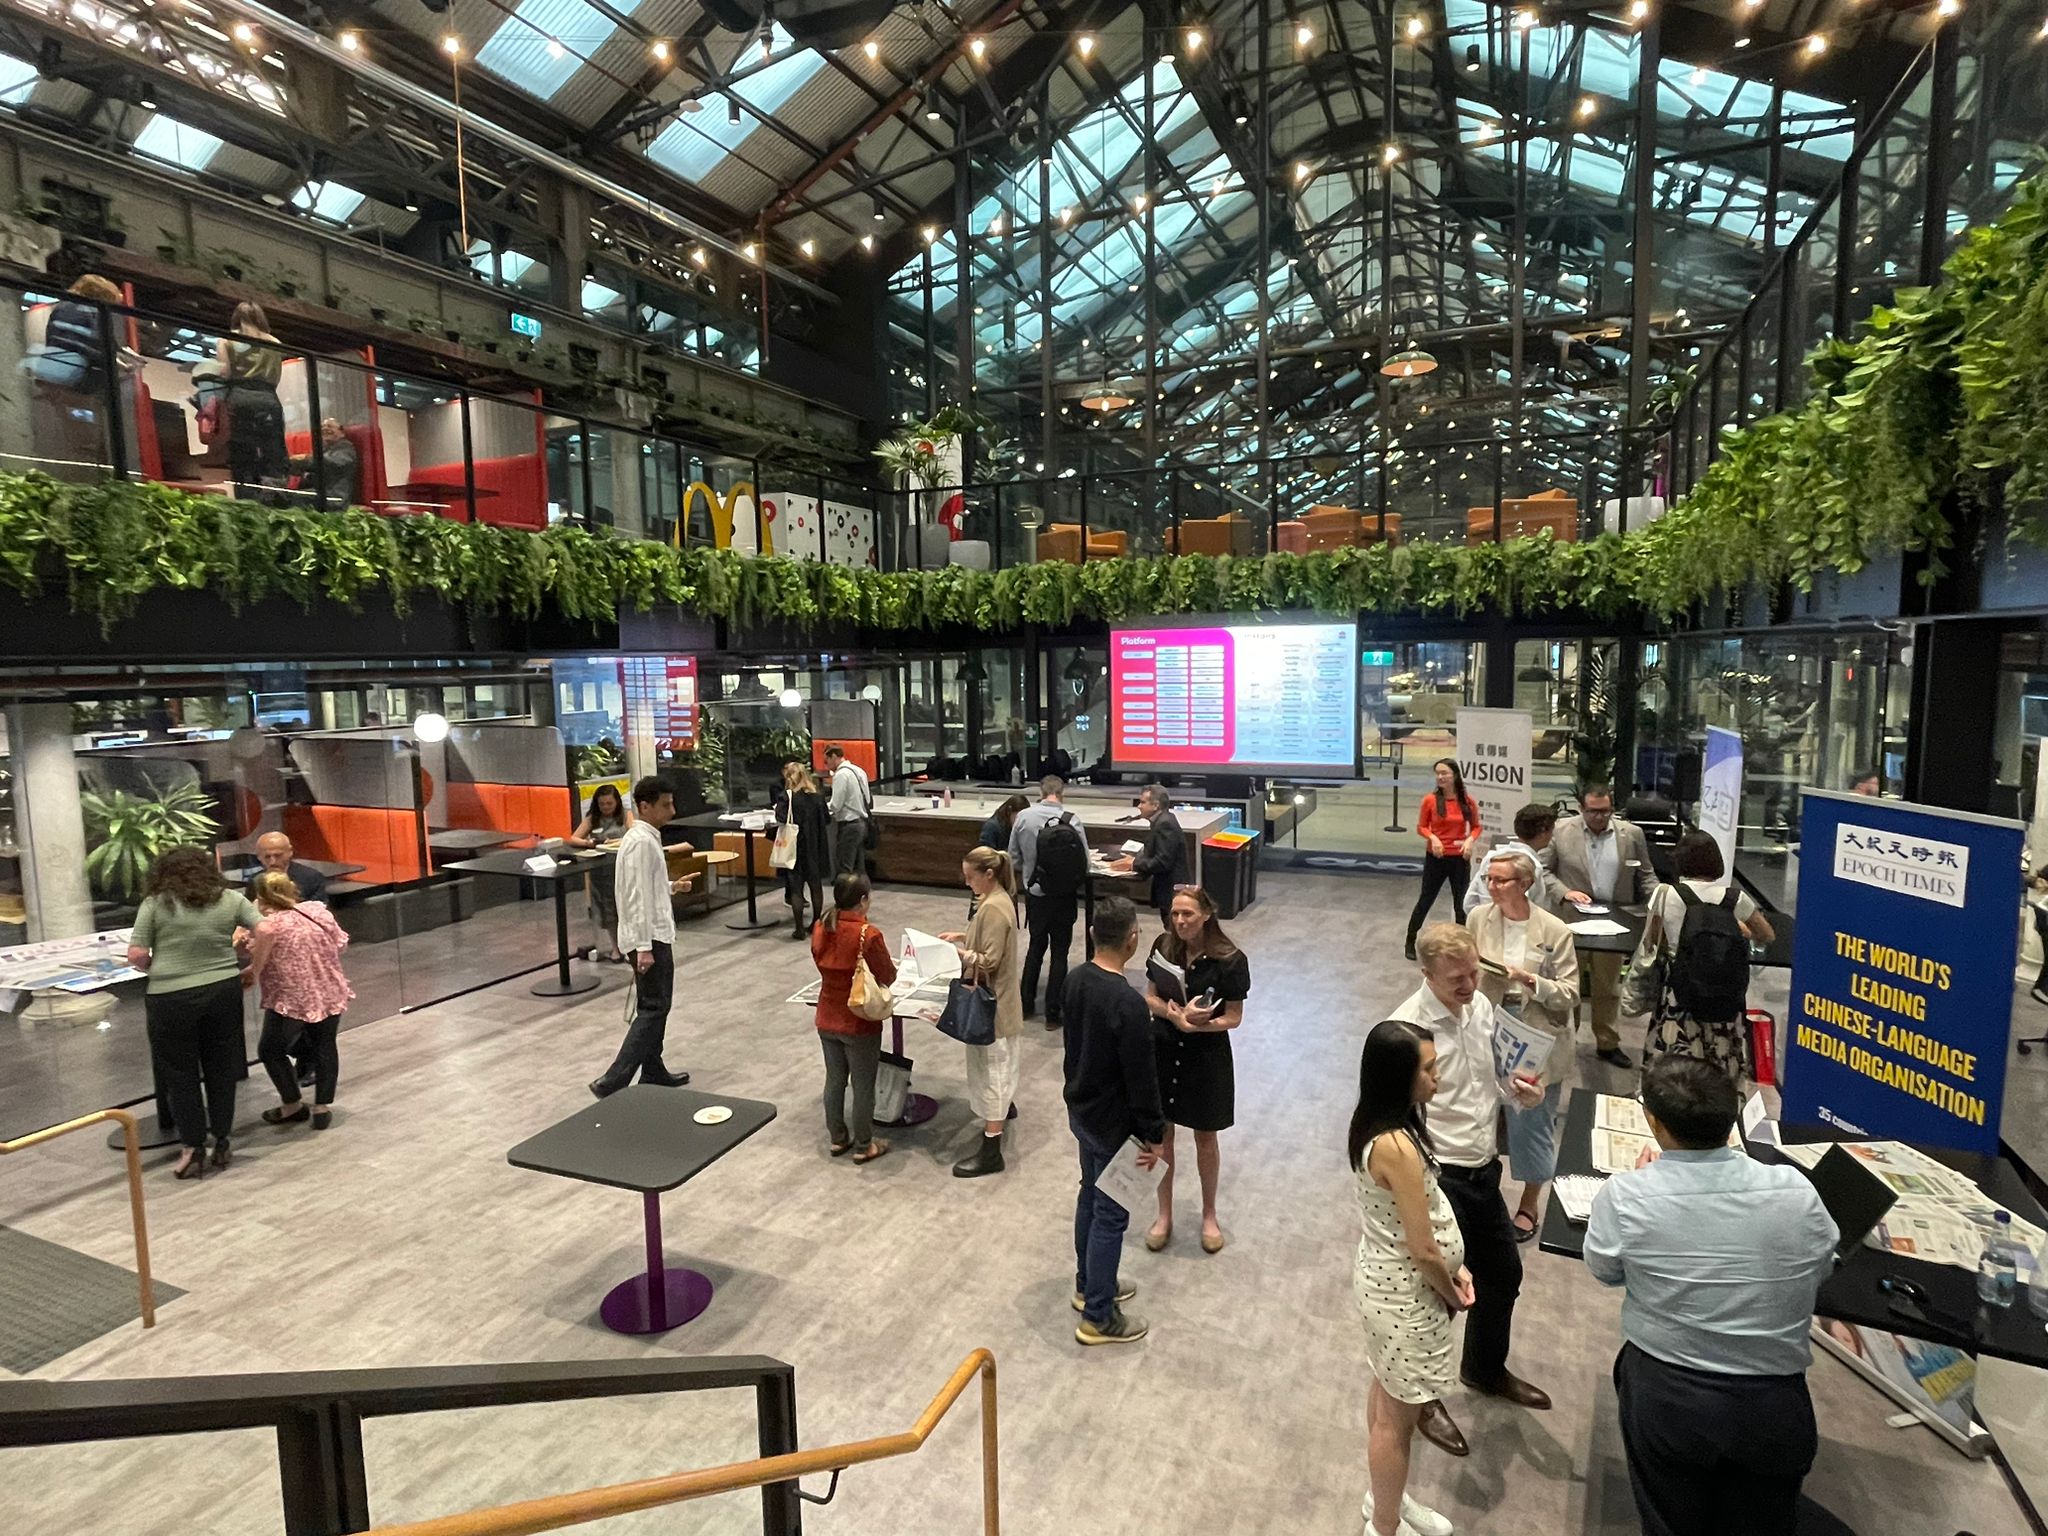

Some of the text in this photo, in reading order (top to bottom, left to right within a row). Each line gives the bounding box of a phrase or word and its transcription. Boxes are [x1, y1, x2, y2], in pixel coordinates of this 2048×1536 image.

[1120, 636, 1156, 646] Platform
[1460, 760, 1524, 786] VISION
[1843, 832, 1959, 869] 大紀元時報
[1842, 857, 1956, 897] EPOCH TIMES
[1836, 932, 1951, 990] THE WORLD'S
[1851, 975, 1926, 1021] LEADING
[1803, 993, 1975, 1082] CHINESE-LANGUAGE
[1797, 1024, 1985, 1125] MEDIA ORGANISATION
[1818, 1105, 1832, 1122] 35
